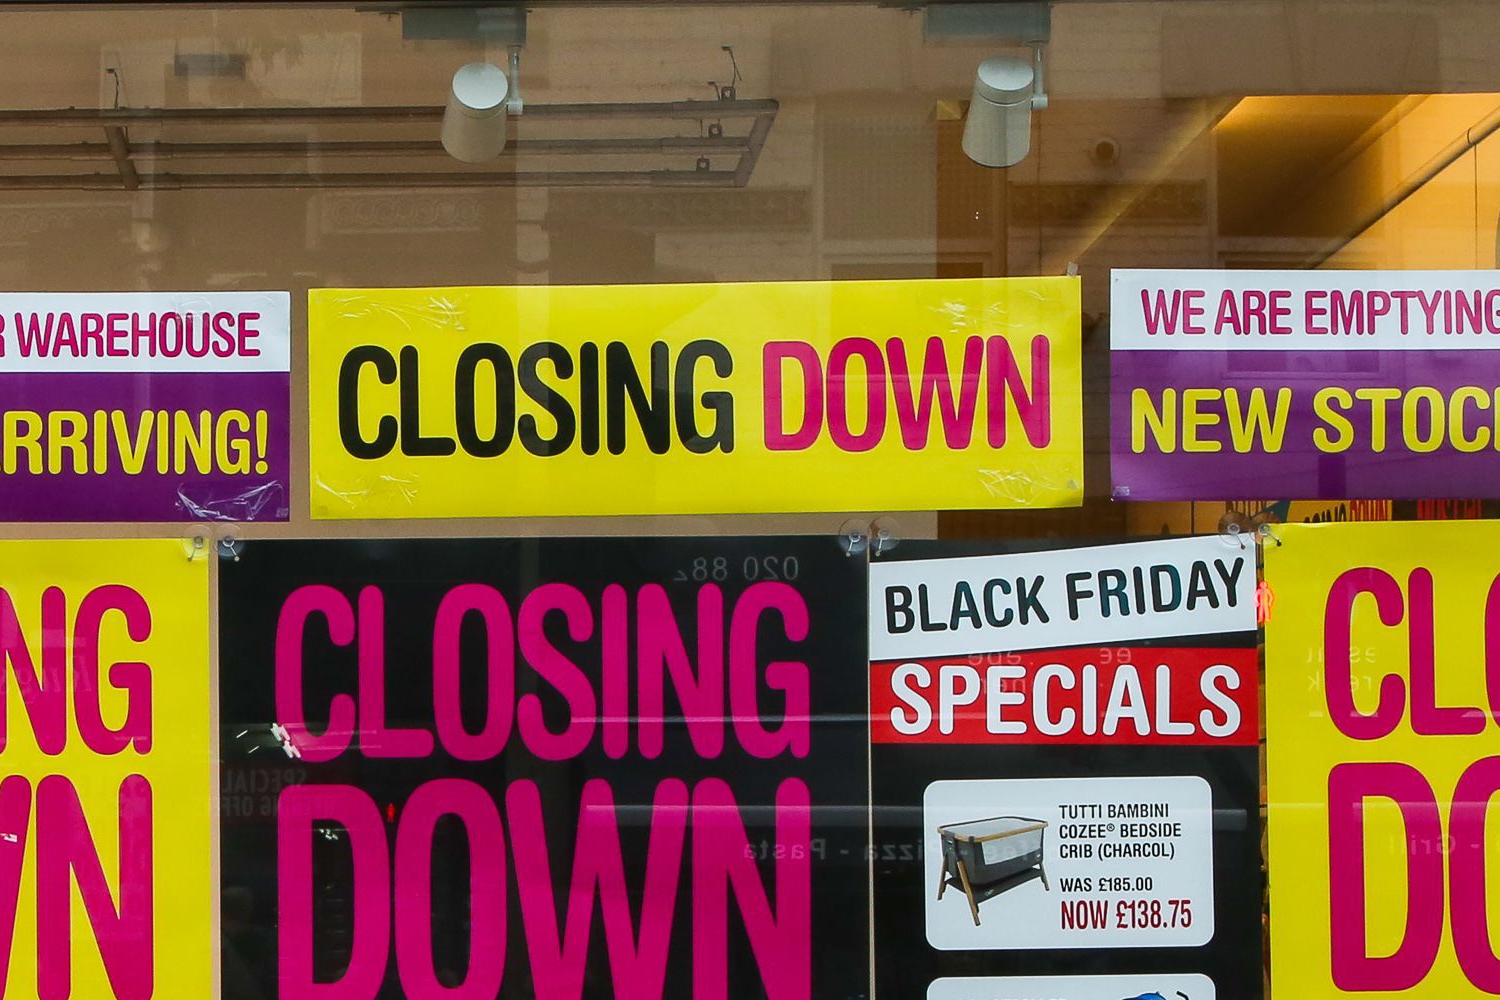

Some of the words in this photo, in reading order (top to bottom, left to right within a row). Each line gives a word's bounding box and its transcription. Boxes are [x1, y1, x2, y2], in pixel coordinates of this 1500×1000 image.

[15, 312, 260, 357] WAREHOUSE
[1141, 289, 1205, 335] WE
[1214, 290, 1292, 335] ARE
[339, 338, 735, 459] CLOSING
[762, 333, 1052, 453] DOWN
[1132, 388, 1292, 453] NEW
[1313, 387, 1500, 453] STOC
[885, 575, 1049, 634] BLACK
[1066, 557, 1244, 620] FRIDAY
[275, 582, 810, 762] CLOSING
[1324, 566, 1500, 742] CL
[891, 662, 1240, 737] SPECIALS
[1059, 805, 1101, 819] TUTTI
[1108, 803, 1168, 818] BAMBINI
[1120, 823, 1181, 837] BEDSIDE
[1060, 844, 1092, 858] CRIB
[1098, 842, 1174, 861] (CHARCOL)
[1060, 878, 1092, 892] WAS
[1099, 877, 1152, 891] £185.00
[1062, 900, 1108, 929] NOW
[1116, 900, 1191, 928] £138.75
